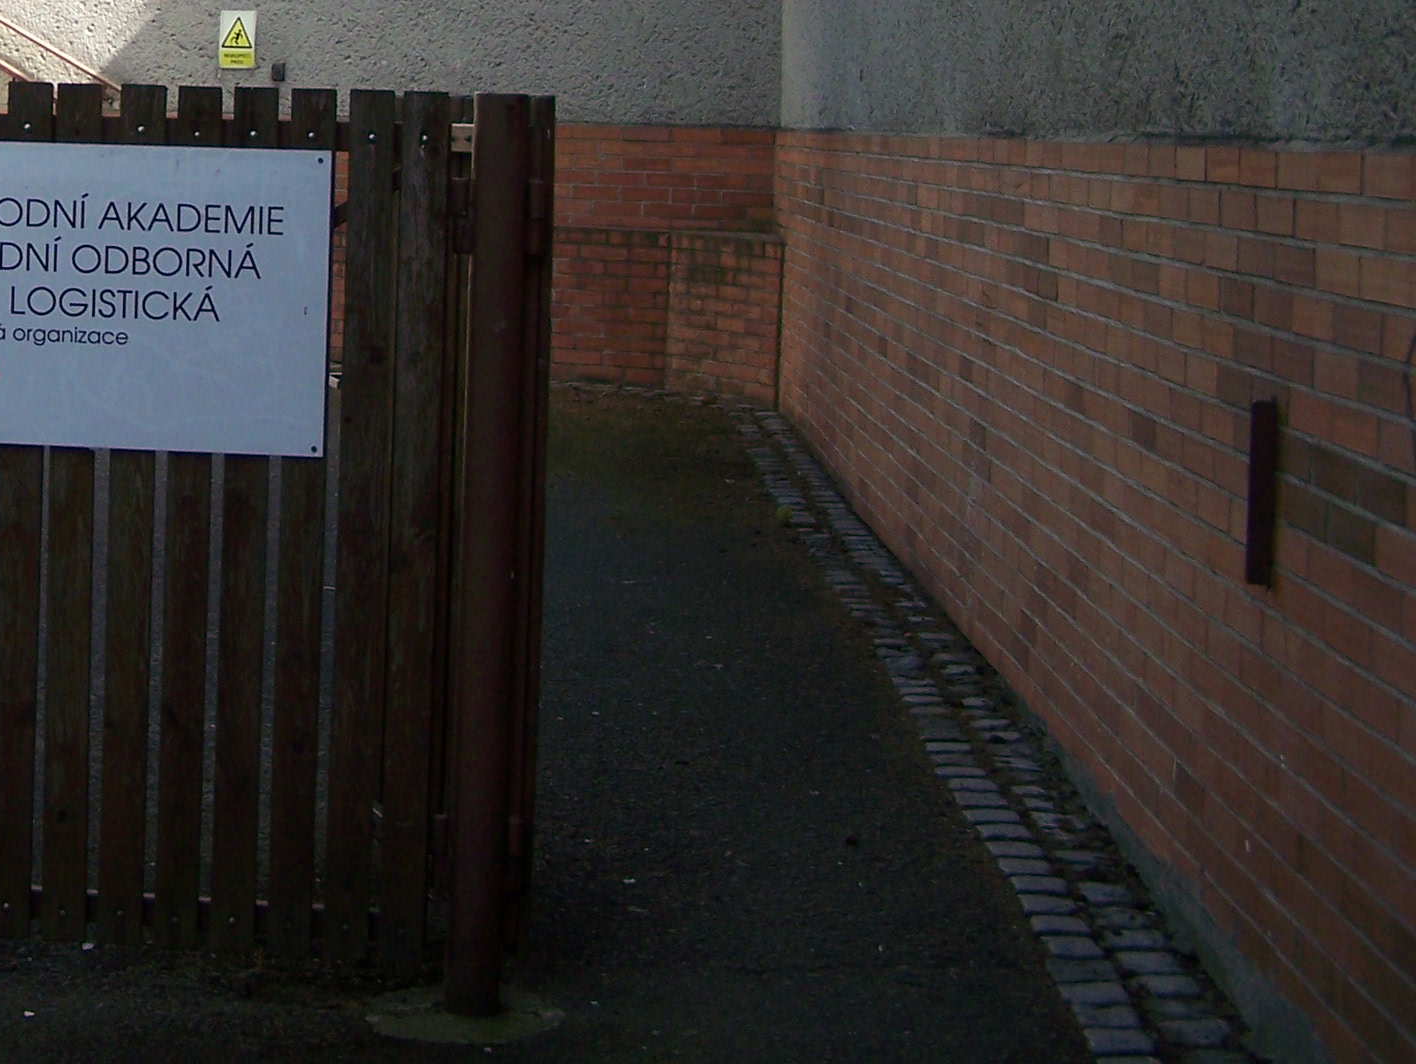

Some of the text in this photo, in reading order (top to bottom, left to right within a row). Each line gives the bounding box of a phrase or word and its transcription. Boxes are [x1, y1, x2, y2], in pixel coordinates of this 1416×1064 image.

[97, 201, 285, 236] AKADEMIE
[71, 242, 262, 280] ODBORNÁ
[10, 285, 220, 323] LOGISTICKÁ
[12, 327, 129, 347] organizace
